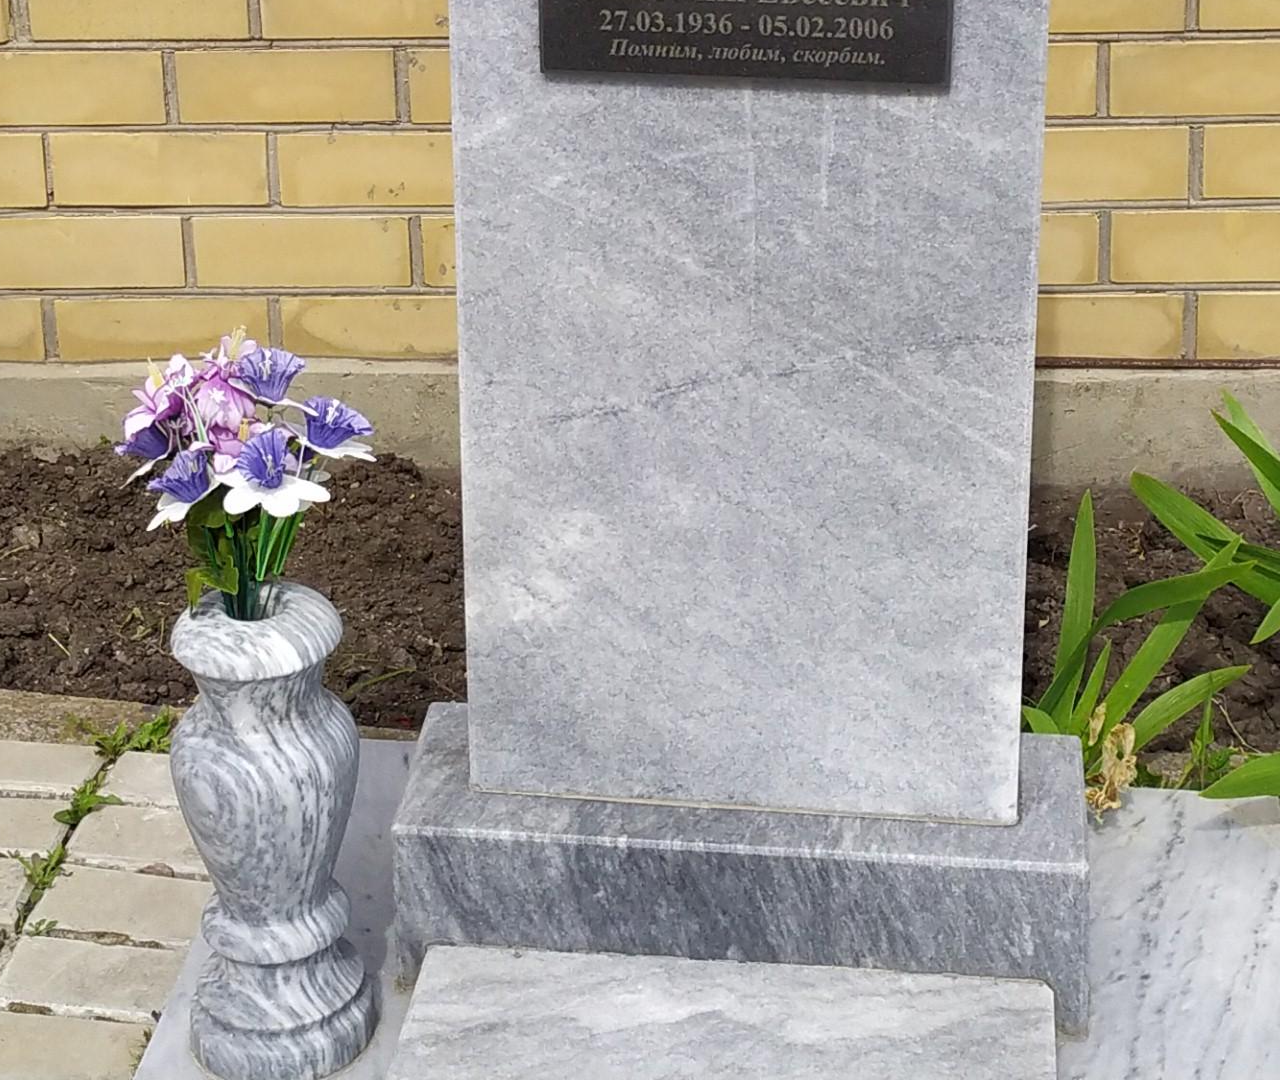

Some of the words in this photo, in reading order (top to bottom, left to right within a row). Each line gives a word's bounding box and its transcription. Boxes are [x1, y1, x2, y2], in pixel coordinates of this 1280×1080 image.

[599, 9, 733, 35] 27.03.1936
[758, 14, 895, 40] 05.02.2006
[608, 38, 703, 61] Помним,
[708, 44, 787, 64] любим,
[792, 47, 886, 67] скорбим.
